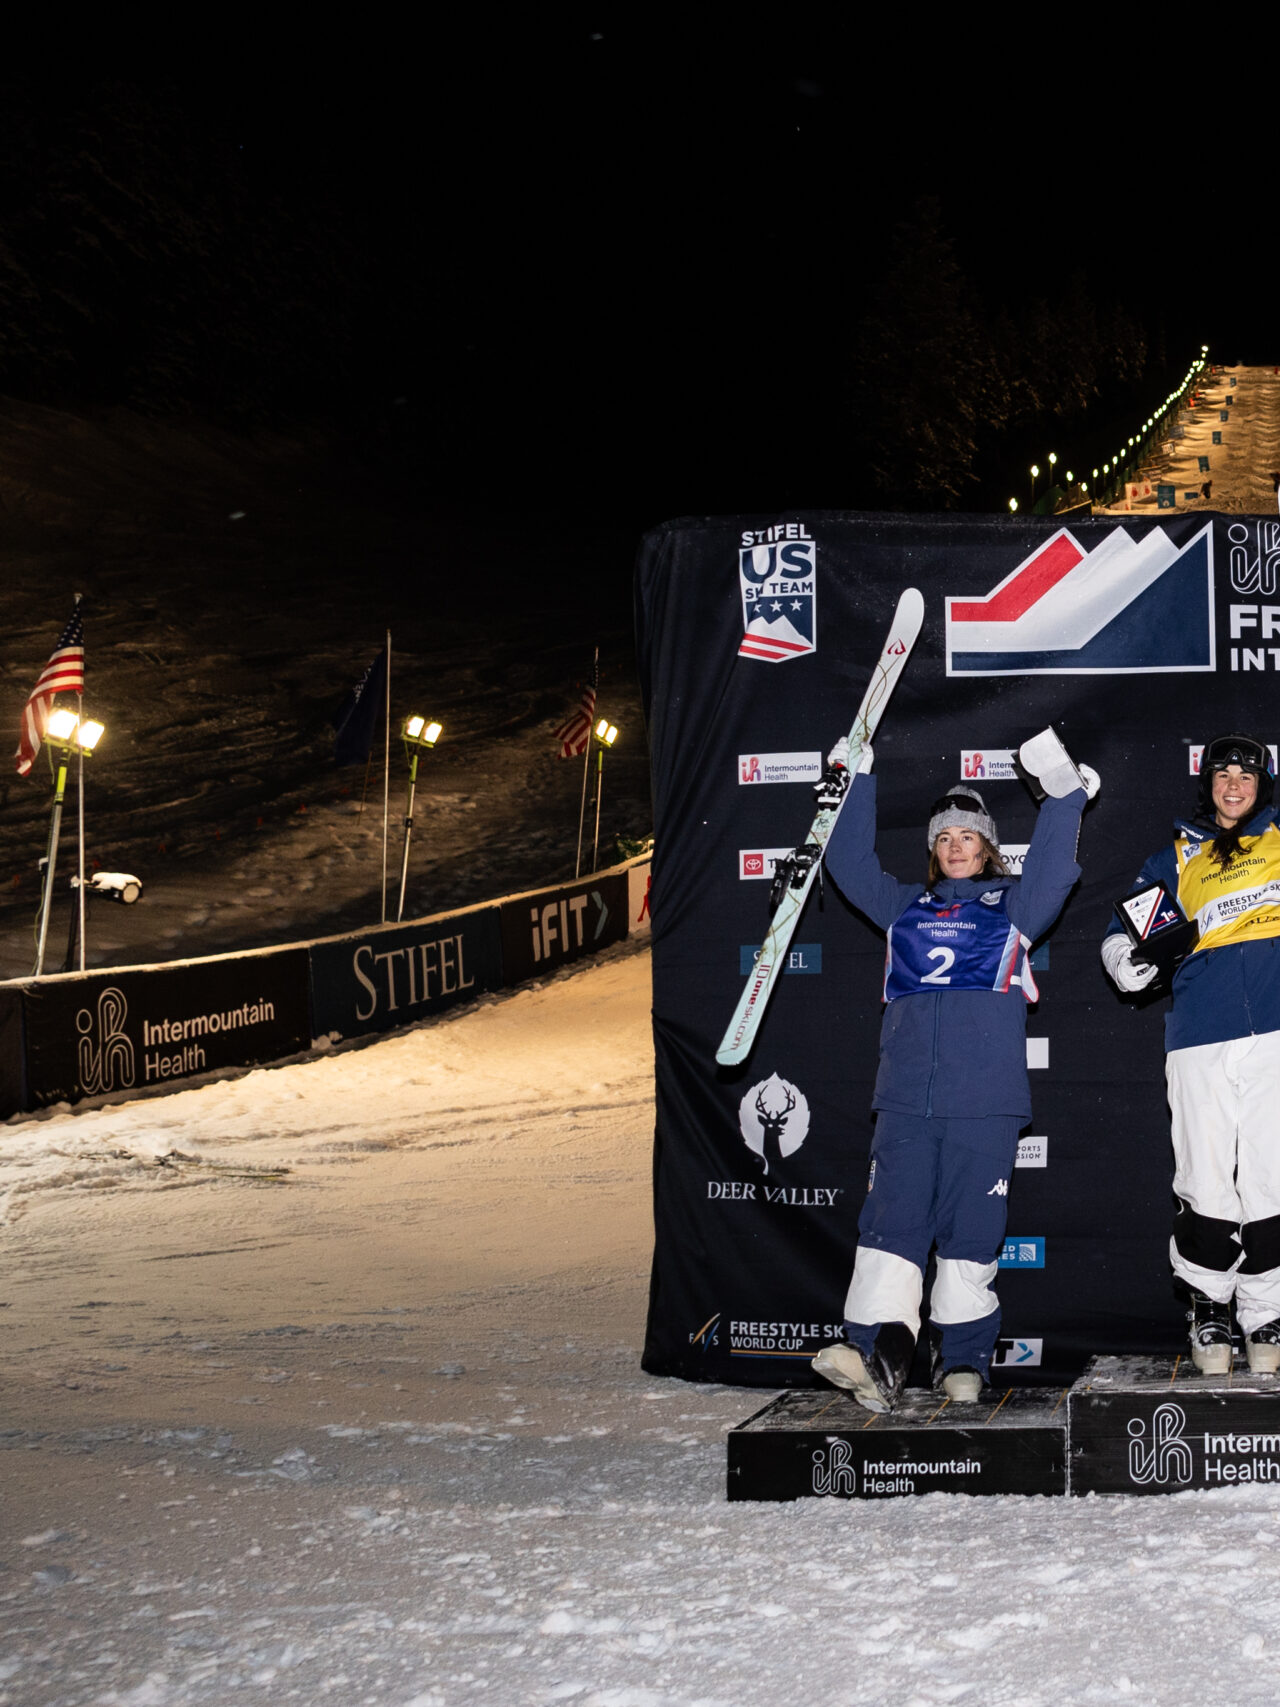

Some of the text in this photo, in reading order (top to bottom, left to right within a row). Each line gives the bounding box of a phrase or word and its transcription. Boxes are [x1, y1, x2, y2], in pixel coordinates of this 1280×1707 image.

[742, 523, 811, 546] STIFEL
[742, 543, 813, 584] US
[769, 581, 813, 594] TEAM
[764, 763, 819, 773] Intermountain
[764, 772, 789, 781] Health
[989, 769, 1015, 778] Health
[1219, 869, 1250, 885] Health
[1220, 904, 1248, 917] WORLD
[531, 894, 588, 962] iFIT
[917, 921, 977, 931] Intermountain
[931, 929, 958, 938] Health
[920, 946, 956, 985] 2
[353, 934, 475, 1021] STIFEL
[143, 998, 275, 1047] Intermountain
[145, 1044, 206, 1081] Health
[707, 1181, 840, 1206] DEER VALLEY
[730, 1321, 845, 1338] FREESTYLE SK
[730, 1336, 774, 1350] WORLD
[778, 1338, 803, 1351] CUP
[863, 1458, 981, 1475] Intermountain
[1204, 1458, 1280, 1481] Health
[863, 1477, 915, 1493] Health
